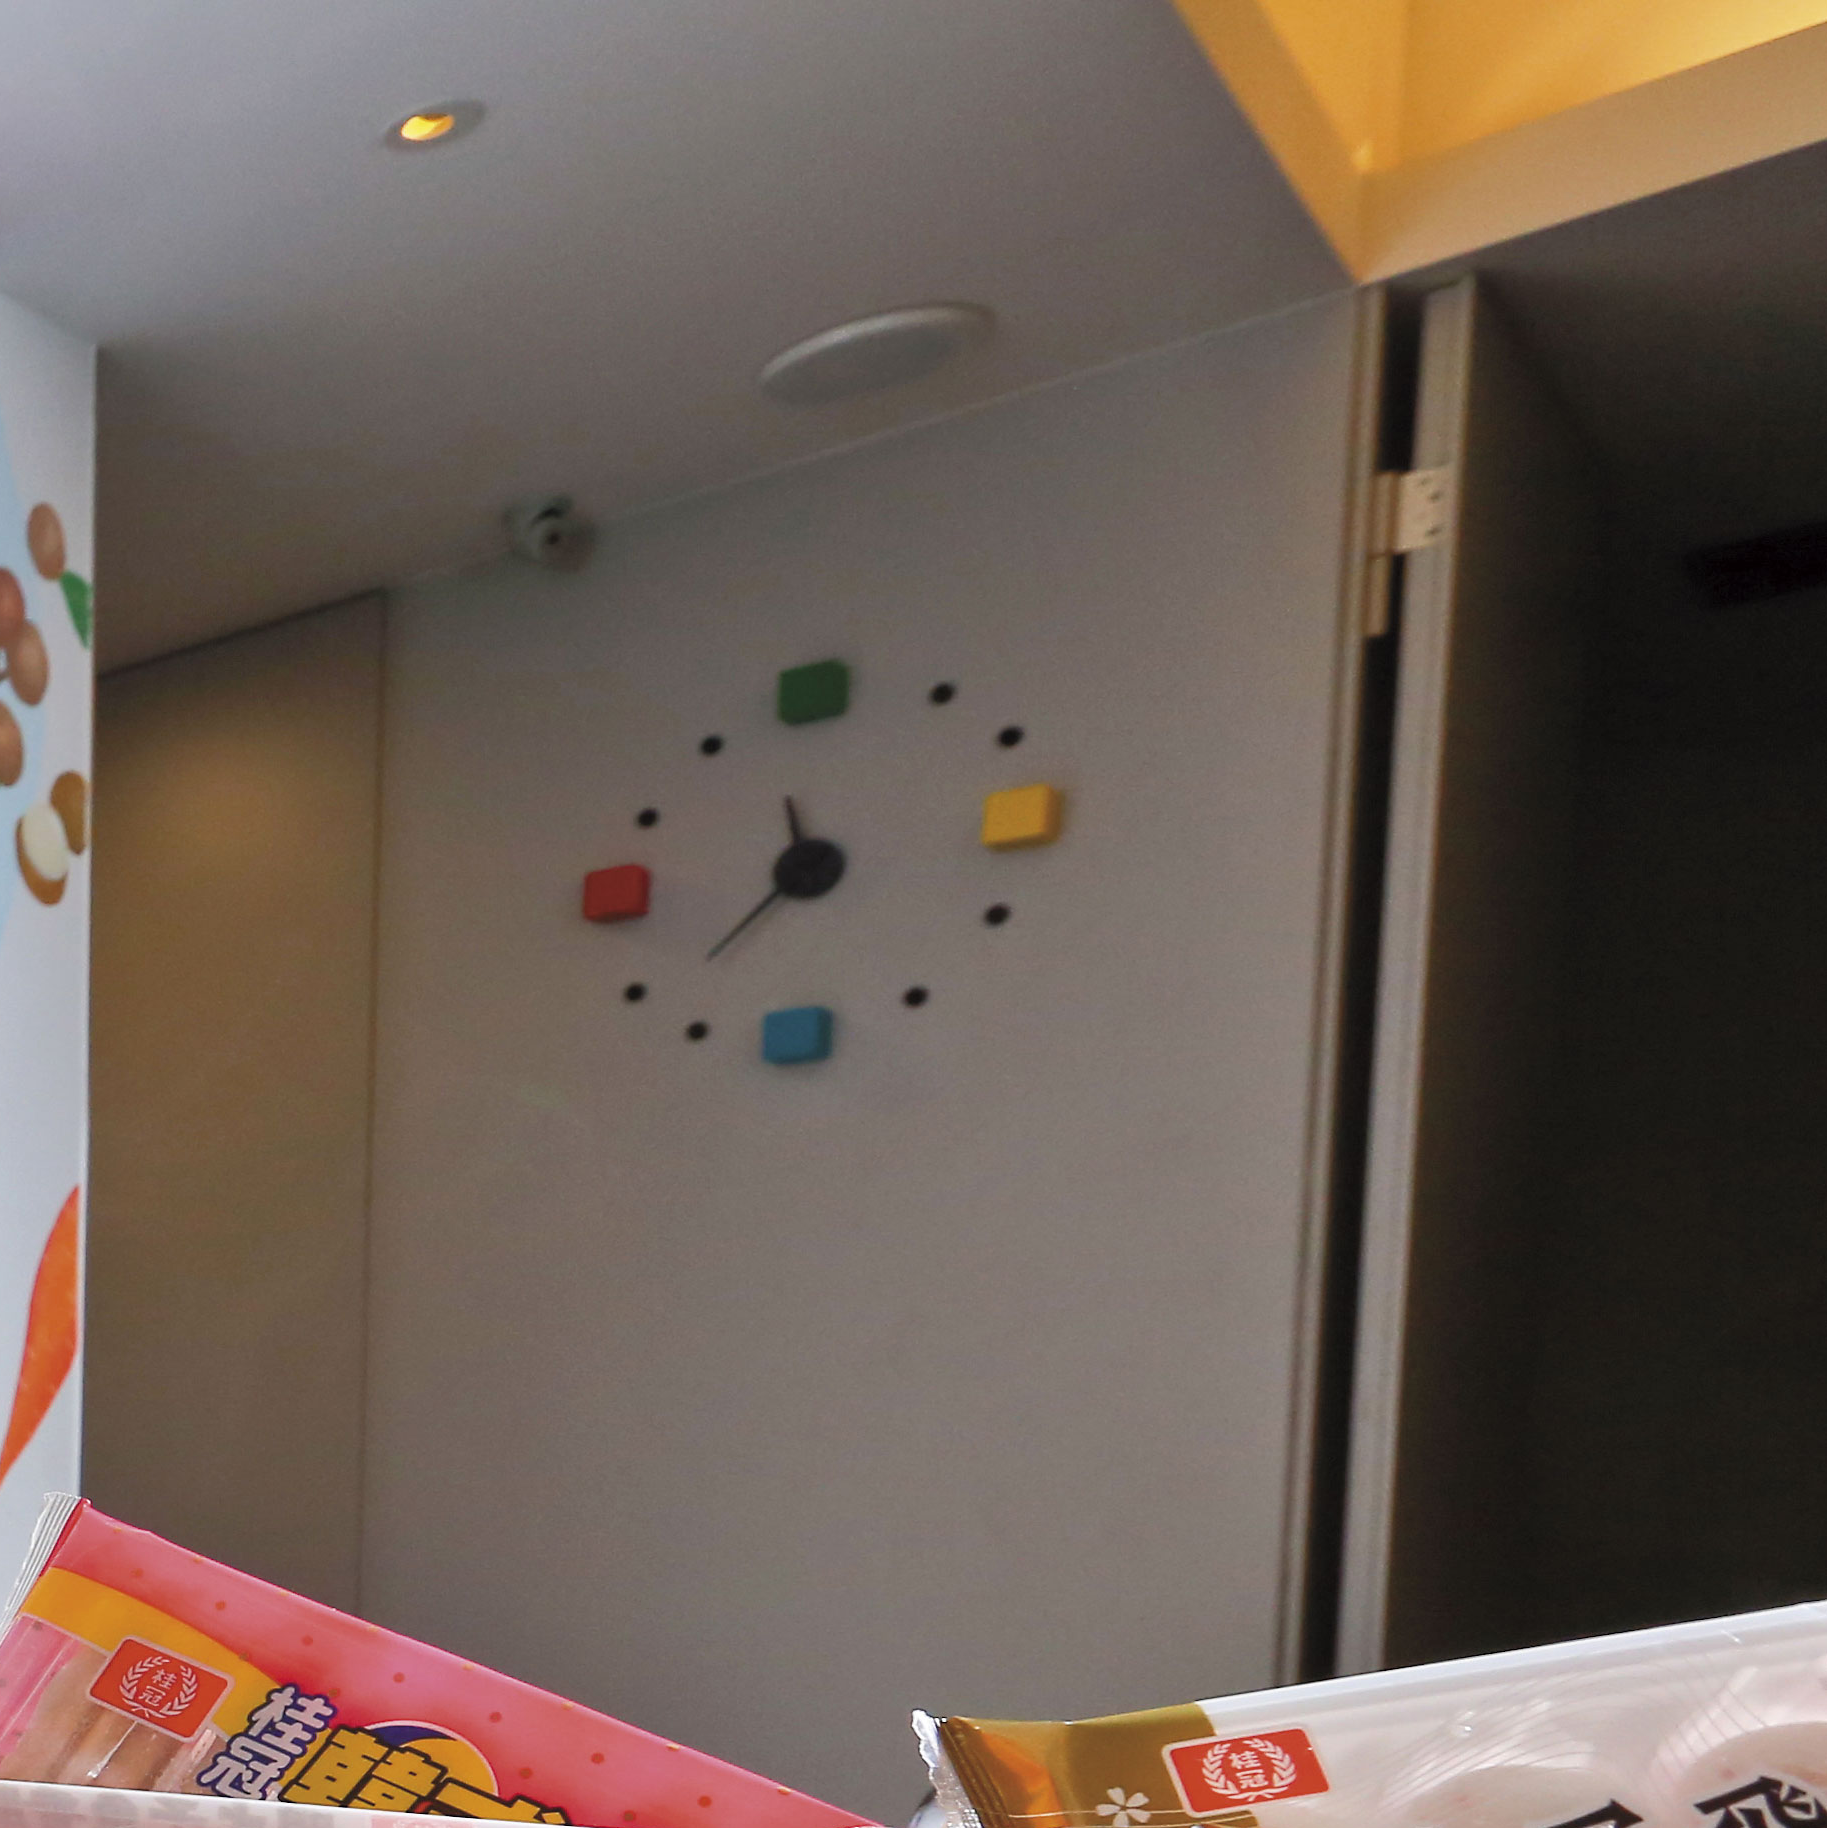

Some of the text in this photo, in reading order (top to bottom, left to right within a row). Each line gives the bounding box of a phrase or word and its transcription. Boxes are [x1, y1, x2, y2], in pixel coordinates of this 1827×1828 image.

[137, 1668, 177, 1707] 桂冠
[199, 1685, 335, 1802] 桂冠
[1227, 1750, 1270, 1790] 桂冠
